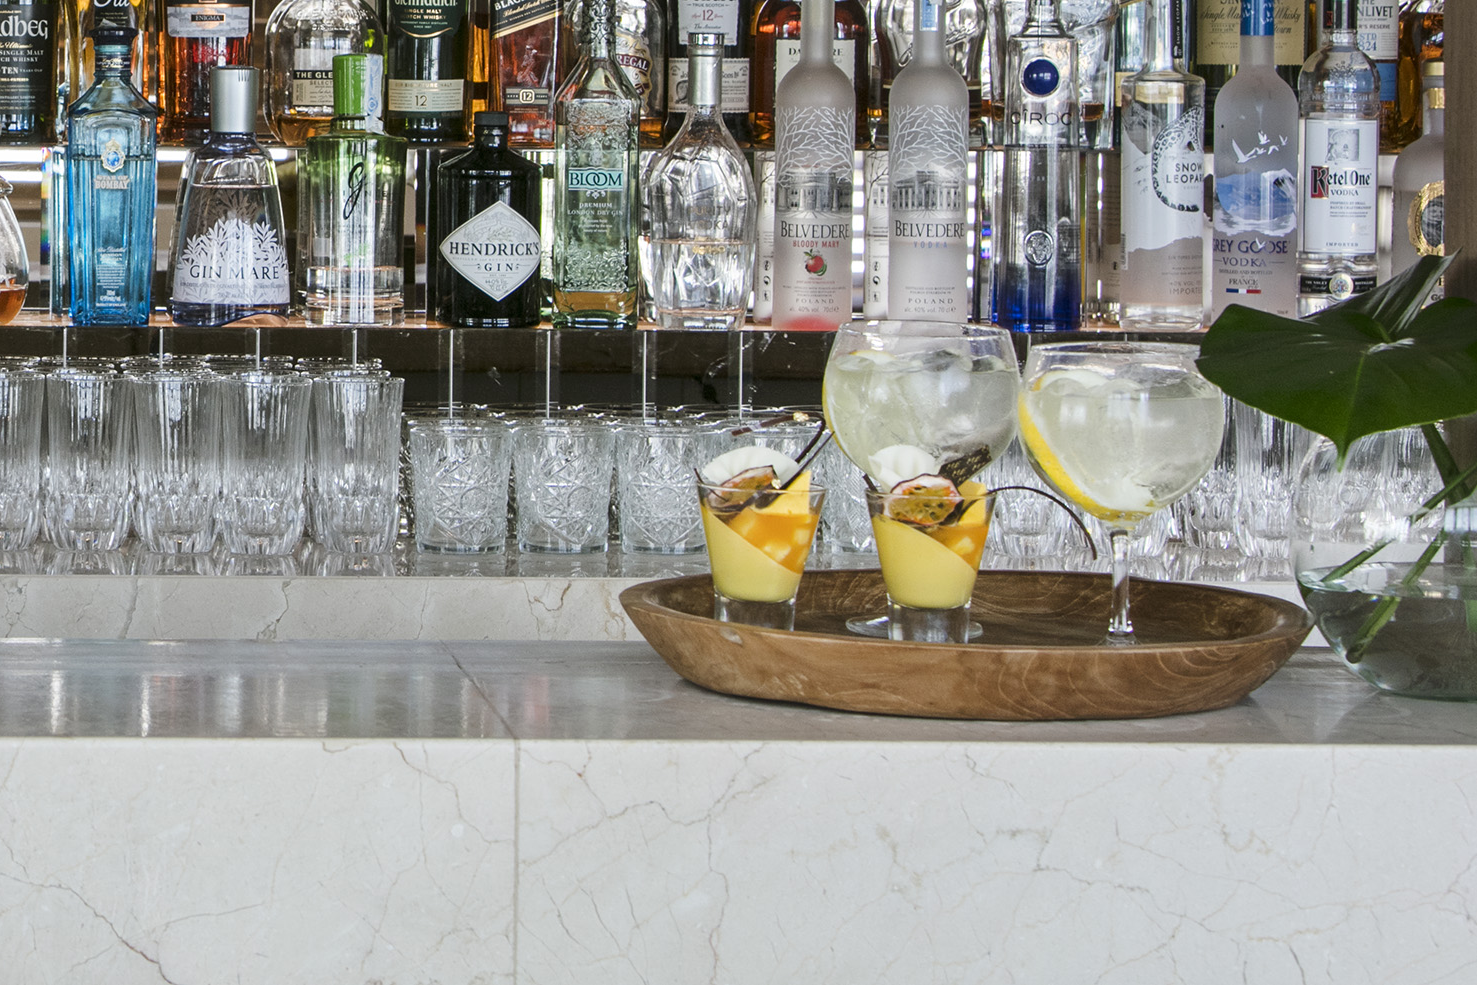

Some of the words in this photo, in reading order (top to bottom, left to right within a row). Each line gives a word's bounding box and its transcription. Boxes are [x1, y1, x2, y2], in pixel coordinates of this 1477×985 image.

[702, 9, 714, 21] 12
[1357, 5, 1394, 19] NLIVET
[1359, 32, 1377, 41] STD
[1358, 41, 1377, 52] 824
[616, 53, 648, 71] REGAL
[1, 66, 19, 74] TEN
[414, 94, 428, 107] 12
[523, 92, 532, 101] 12
[1010, 108, 1072, 126] CÎROC
[1175, 162, 1203, 173] SNOW
[570, 172, 622, 186] BLOOM
[1166, 173, 1204, 183] LEOPAR
[1312, 167, 1348, 197] Ketel
[1350, 169, 1370, 186] One
[94, 179, 130, 189] BOMBAY
[611, 209, 623, 217] GIN
[781, 220, 850, 240] BELVEDERE
[895, 220, 964, 239] BELVEDERE
[449, 241, 540, 256] HENDRICK'S
[792, 240, 819, 248] BLOODY
[822, 240, 840, 248] MARY
[1238, 239, 1288, 254] GOOSE
[1222, 256, 1267, 267] VODKA
[190, 264, 222, 278] GIN
[229, 265, 280, 280] MARE
[484, 263, 514, 272] GIN
[1229, 278, 1258, 286] FRANCE
